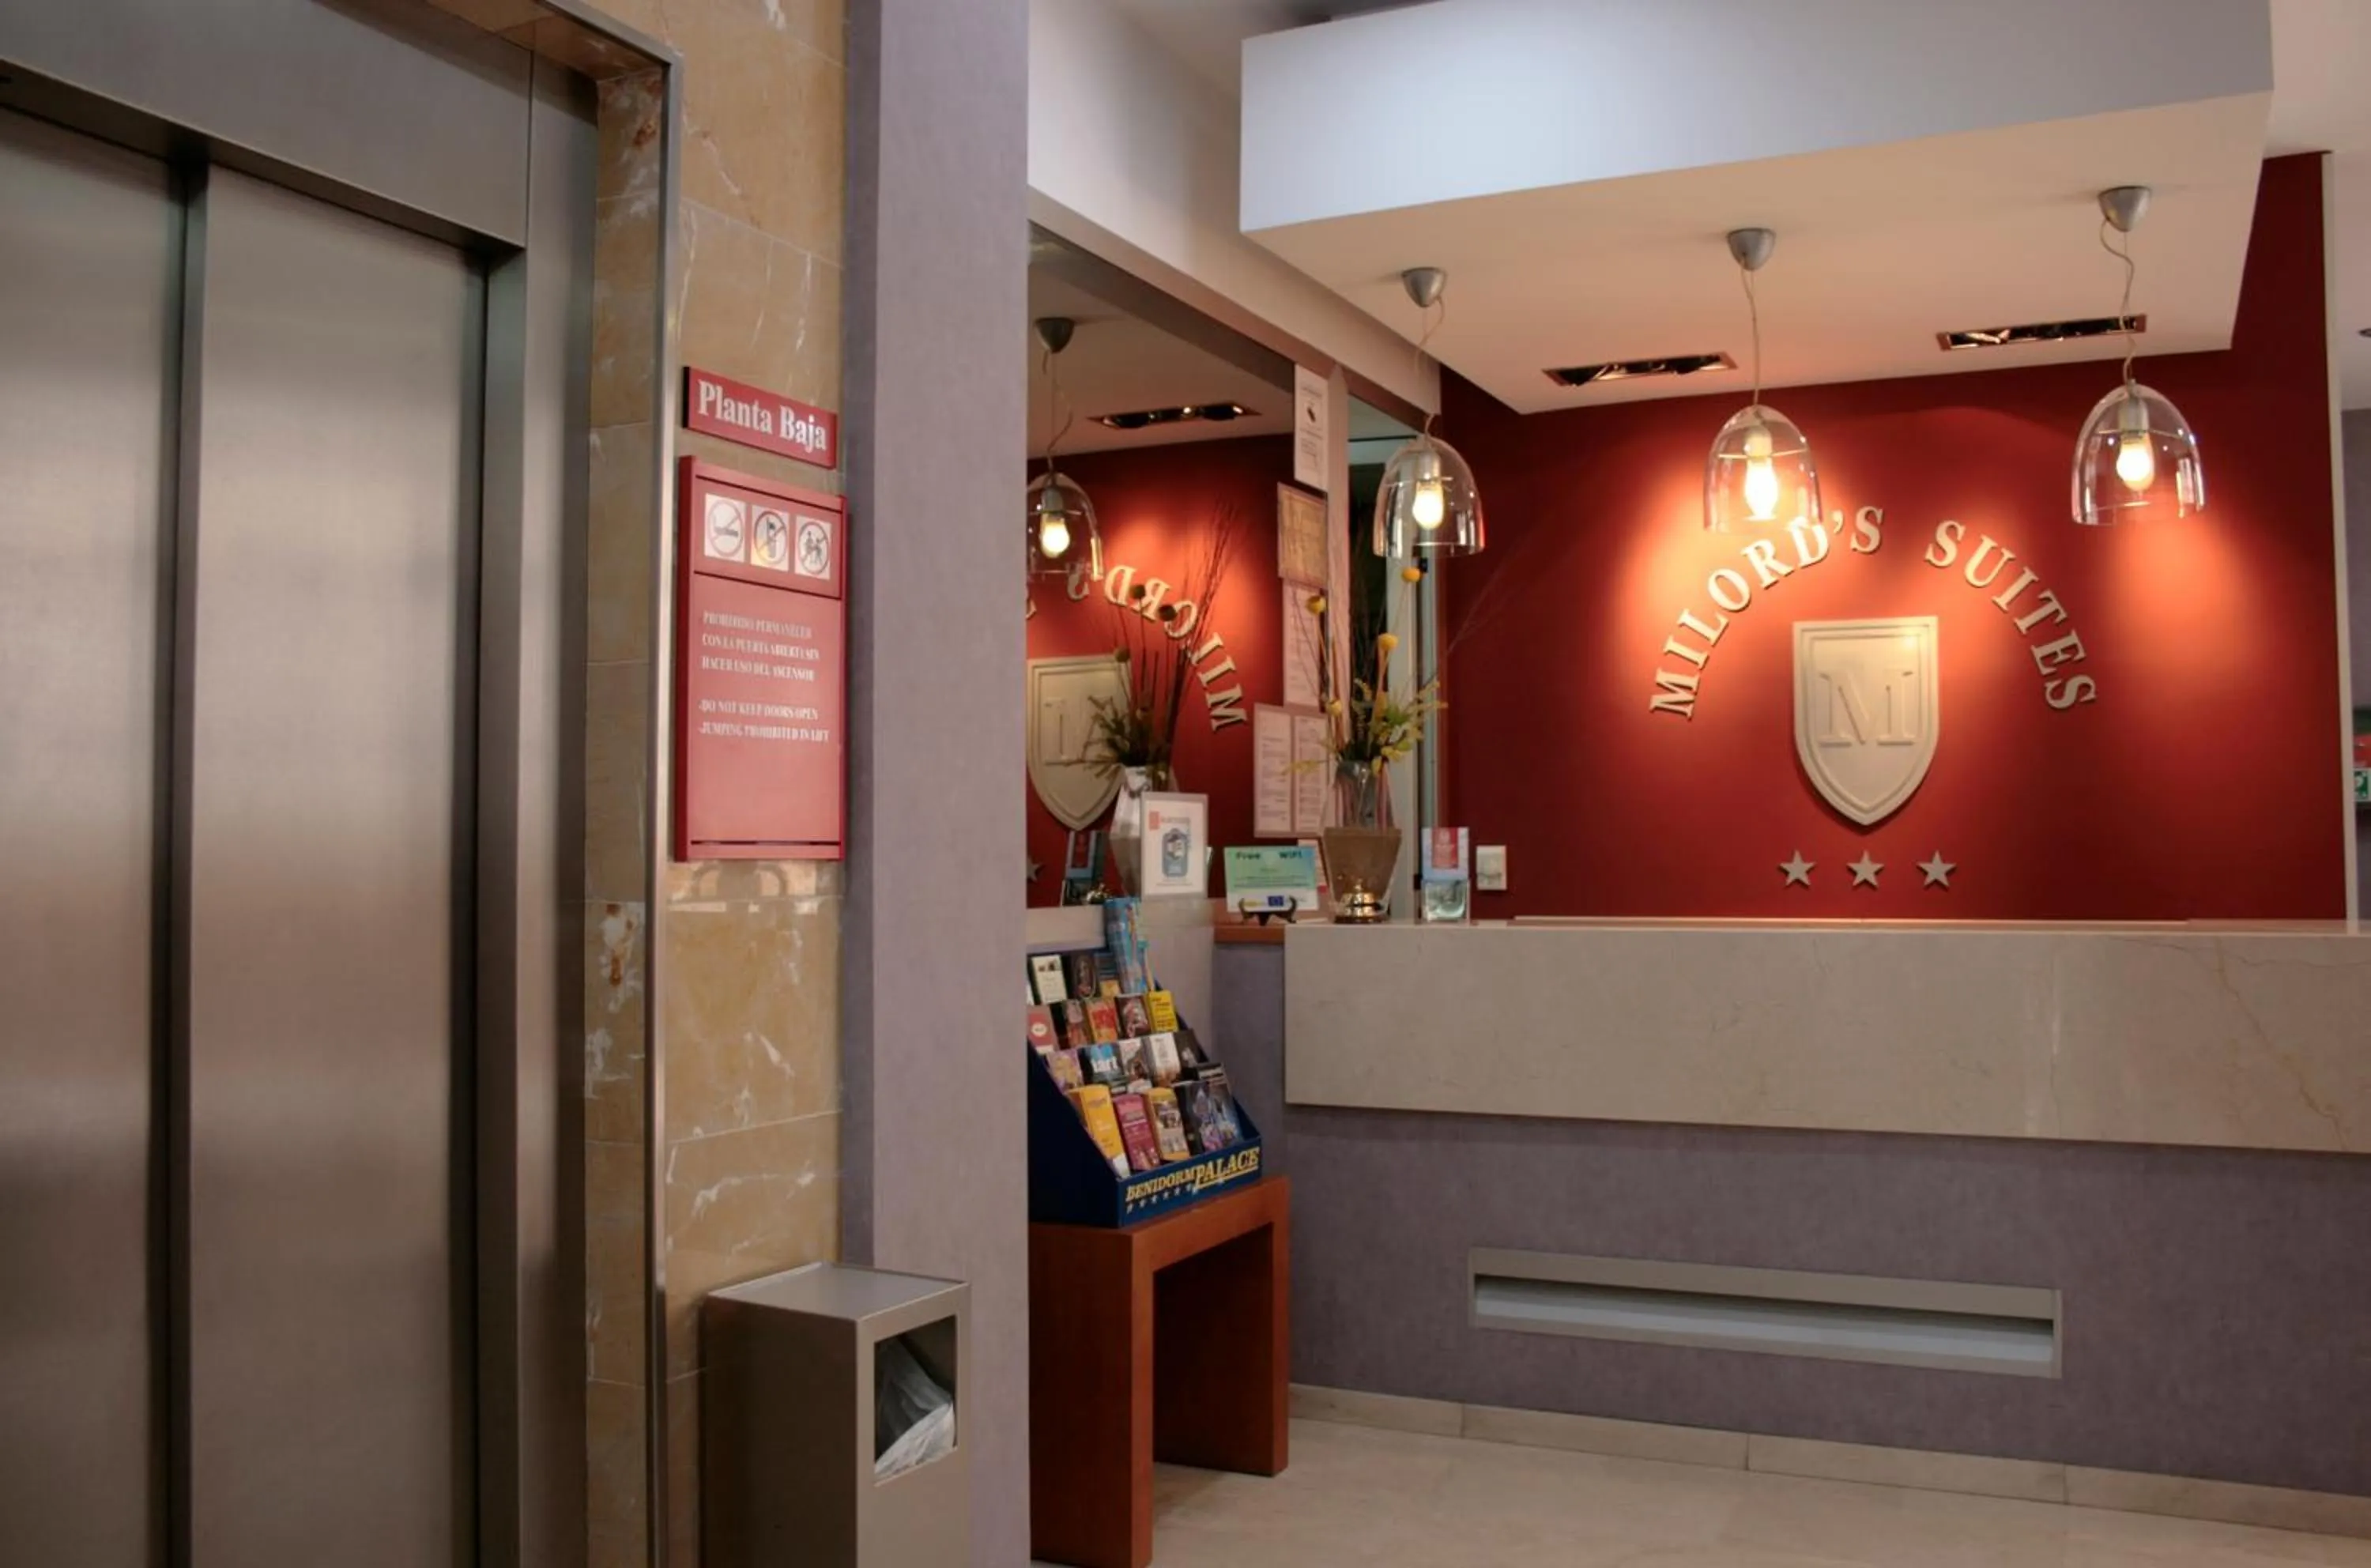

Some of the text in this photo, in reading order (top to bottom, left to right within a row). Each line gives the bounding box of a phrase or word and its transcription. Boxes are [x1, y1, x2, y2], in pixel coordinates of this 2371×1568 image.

[698, 379, 827, 454] Planta Baja
[1649, 506, 2098, 721] MILORD'S SUITES
[1125, 1146, 1261, 1201] BENIDORM PALACE
